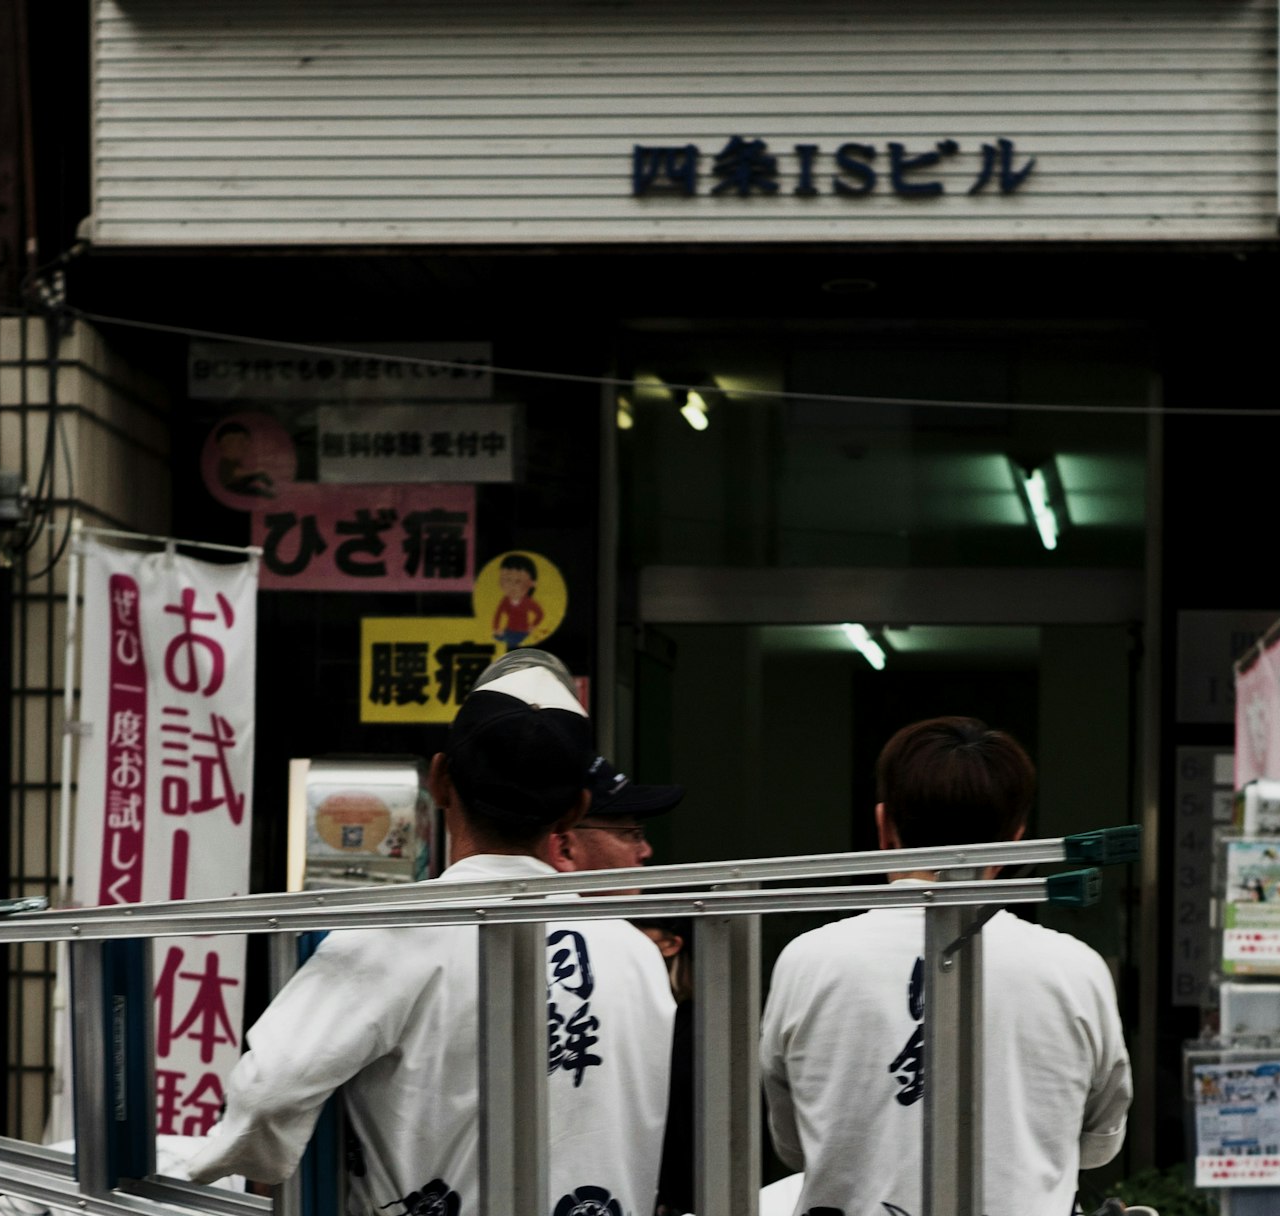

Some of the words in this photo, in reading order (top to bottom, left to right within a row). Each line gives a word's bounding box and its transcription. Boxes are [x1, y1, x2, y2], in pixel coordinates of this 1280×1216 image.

[633, 135, 1037, 197] 四条ISビル
[263, 509, 468, 579] ひざ痛
[369, 640, 497, 707] 腰痛
